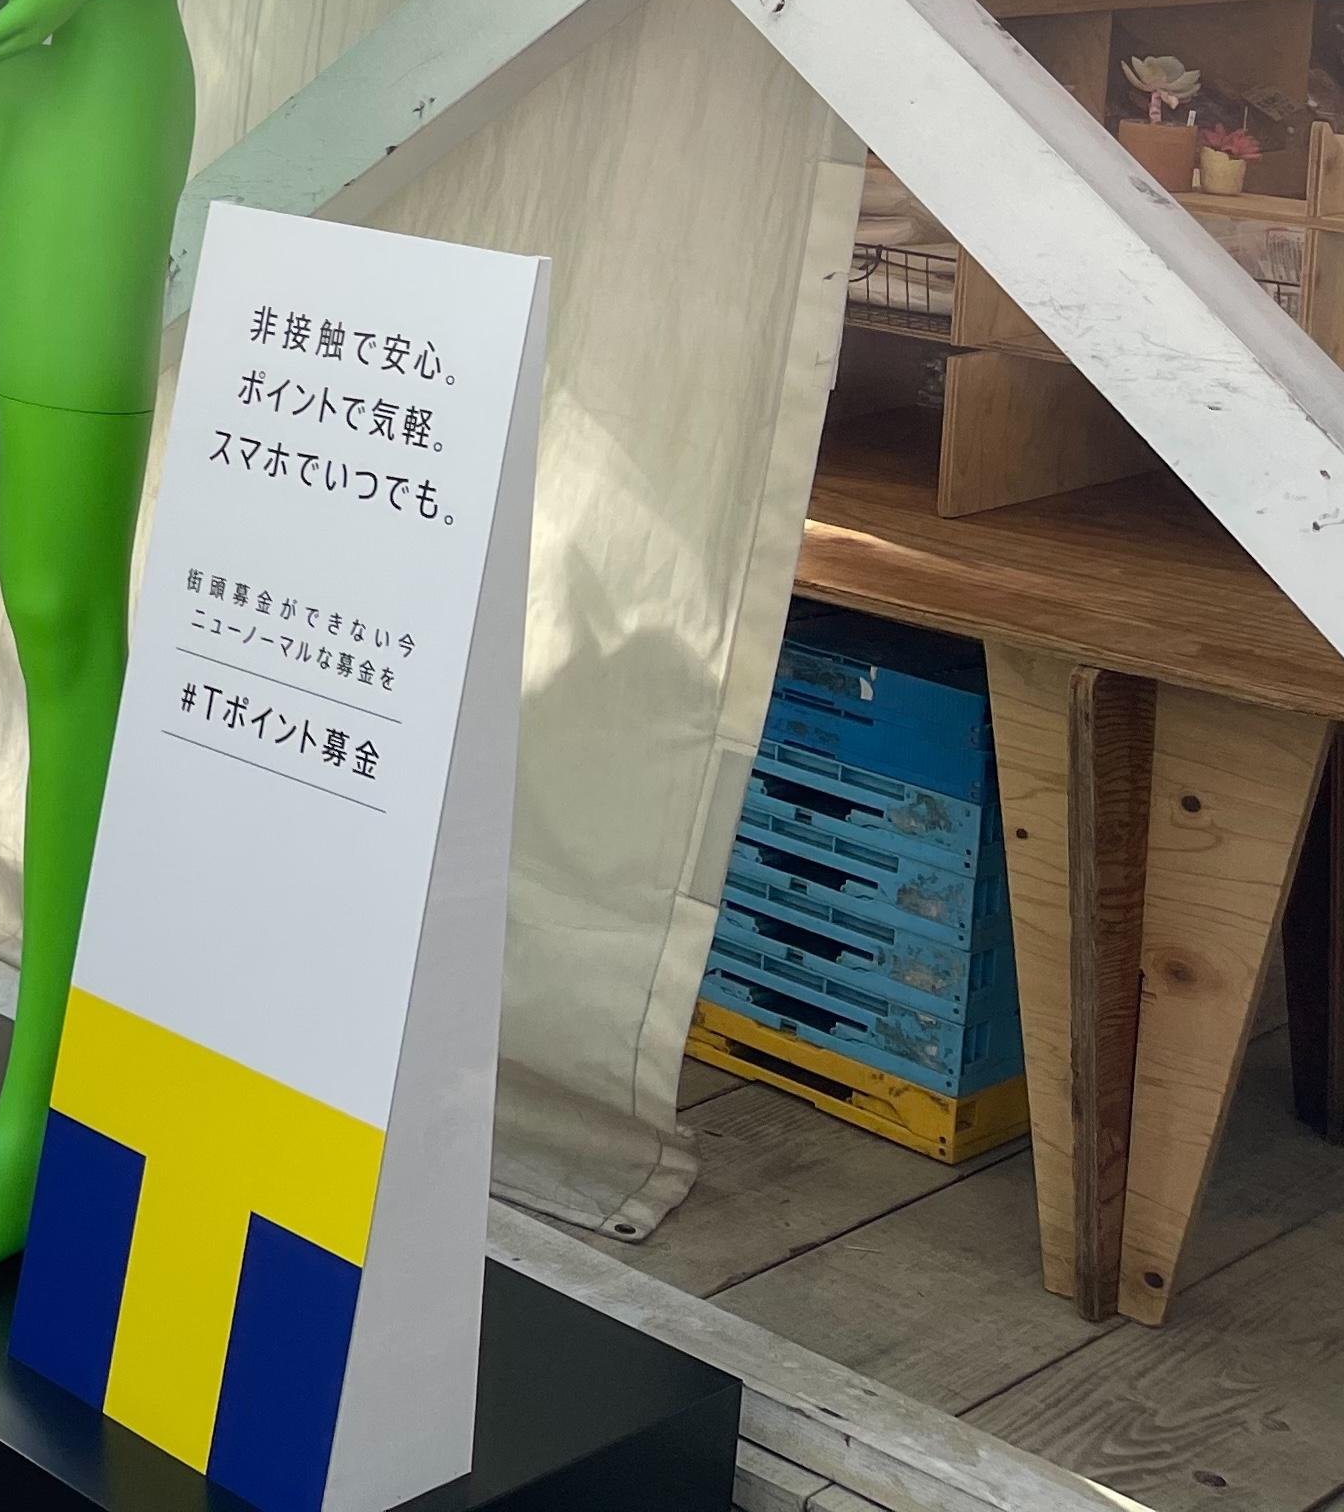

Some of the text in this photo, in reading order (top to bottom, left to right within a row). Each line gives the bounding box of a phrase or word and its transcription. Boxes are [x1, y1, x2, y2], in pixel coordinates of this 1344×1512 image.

[250, 305, 455, 386] 非接触で安心。
[238, 369, 443, 453] ポイントで気軽。
[209, 430, 454, 526] スマホでいつでも。
[186, 568, 416, 657] 街頭募金ができない今
[191, 609, 396, 691] ニューノーマルな募金を
[181, 682, 380, 779] #Tポイント募金
